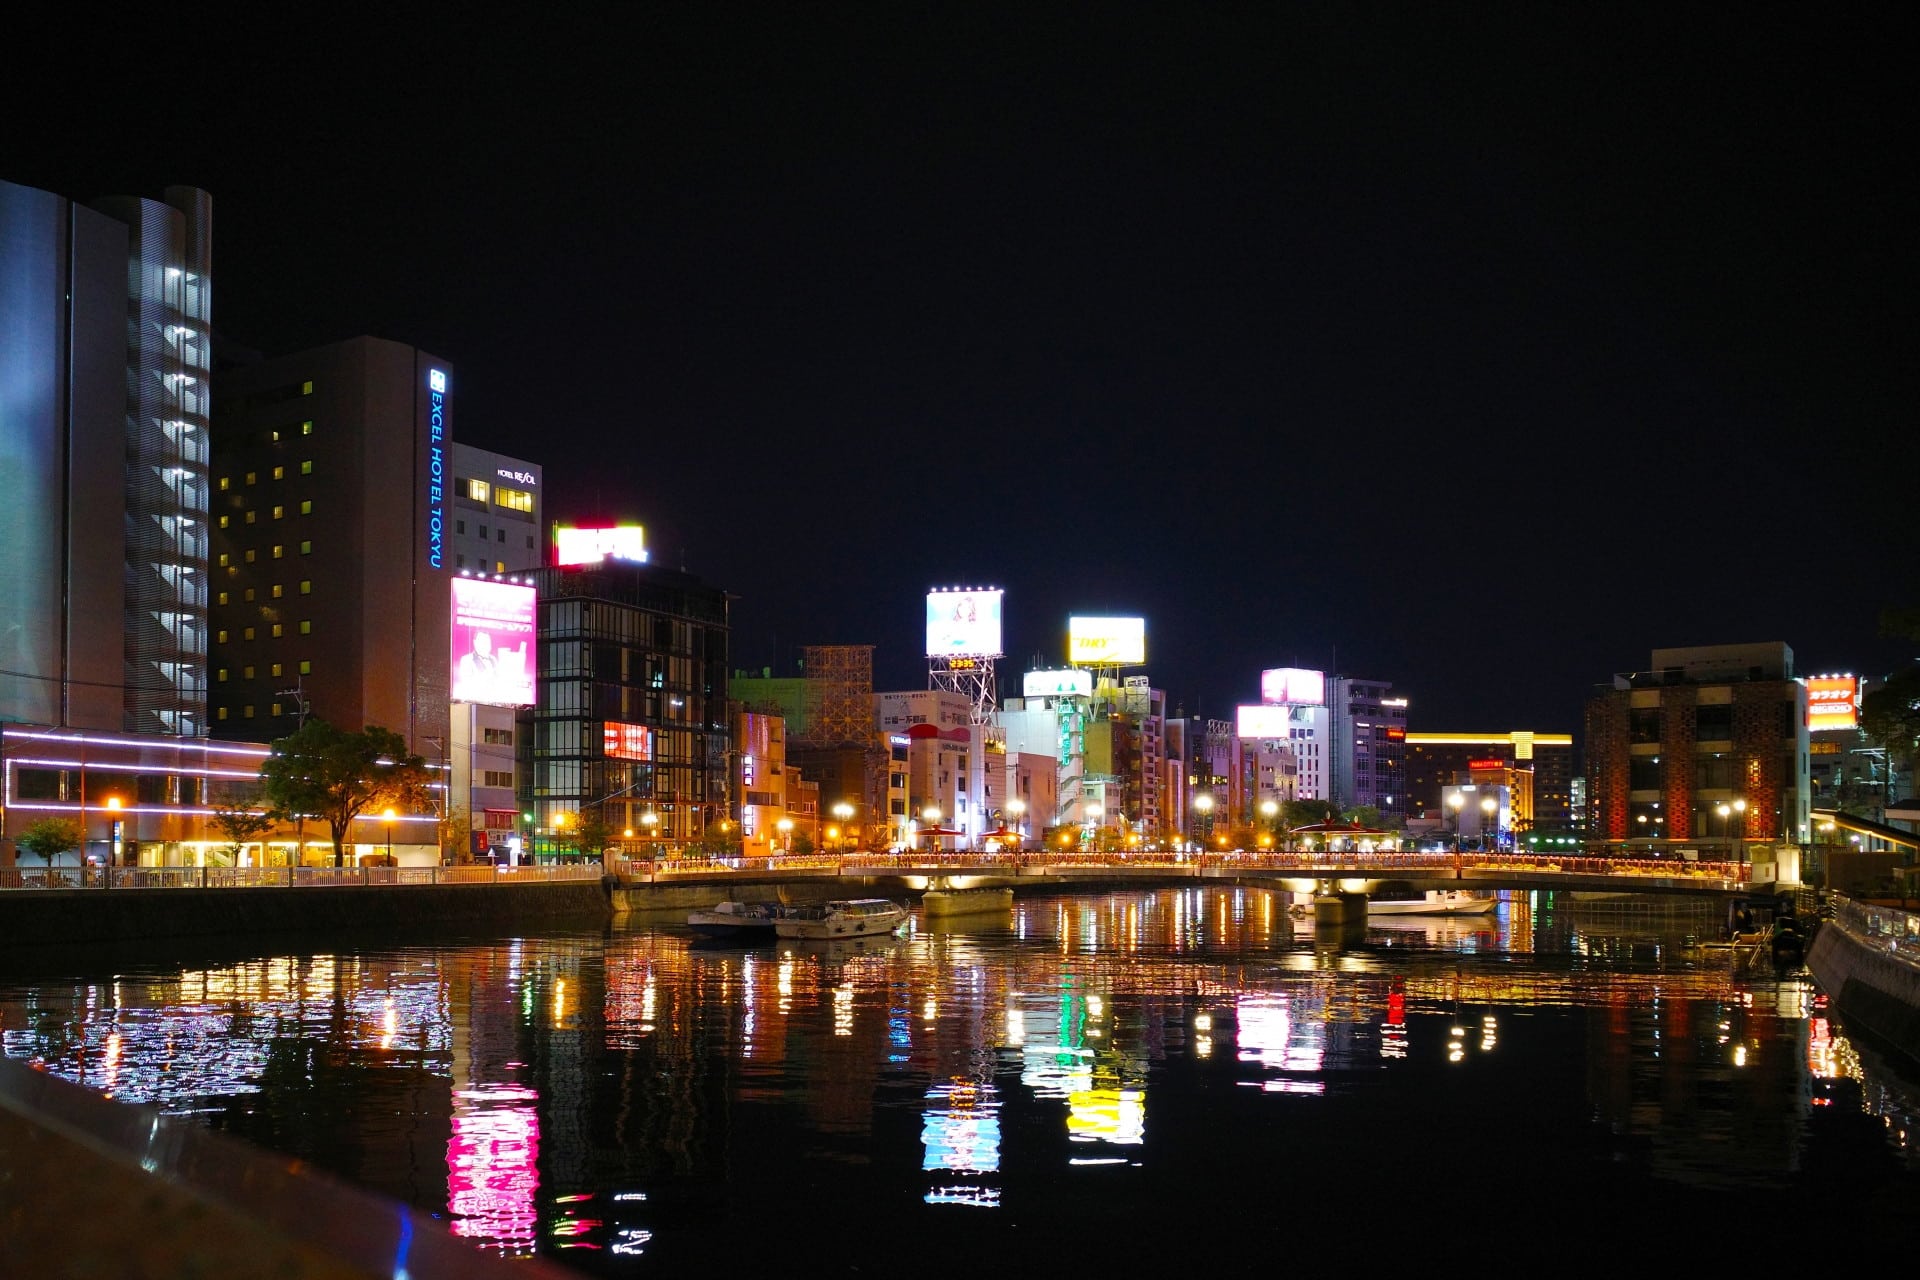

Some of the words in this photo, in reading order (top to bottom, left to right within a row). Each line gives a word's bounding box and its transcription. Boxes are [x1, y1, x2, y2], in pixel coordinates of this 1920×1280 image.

[431, 392, 442, 443] EXCEL
[431, 447, 442, 504] HOTEL
[497, 469, 513, 479] HOTEL
[514, 471, 536, 485] RESOL
[430, 508, 442, 568] TOKYU
[1809, 690, 1852, 700] カラオケ
